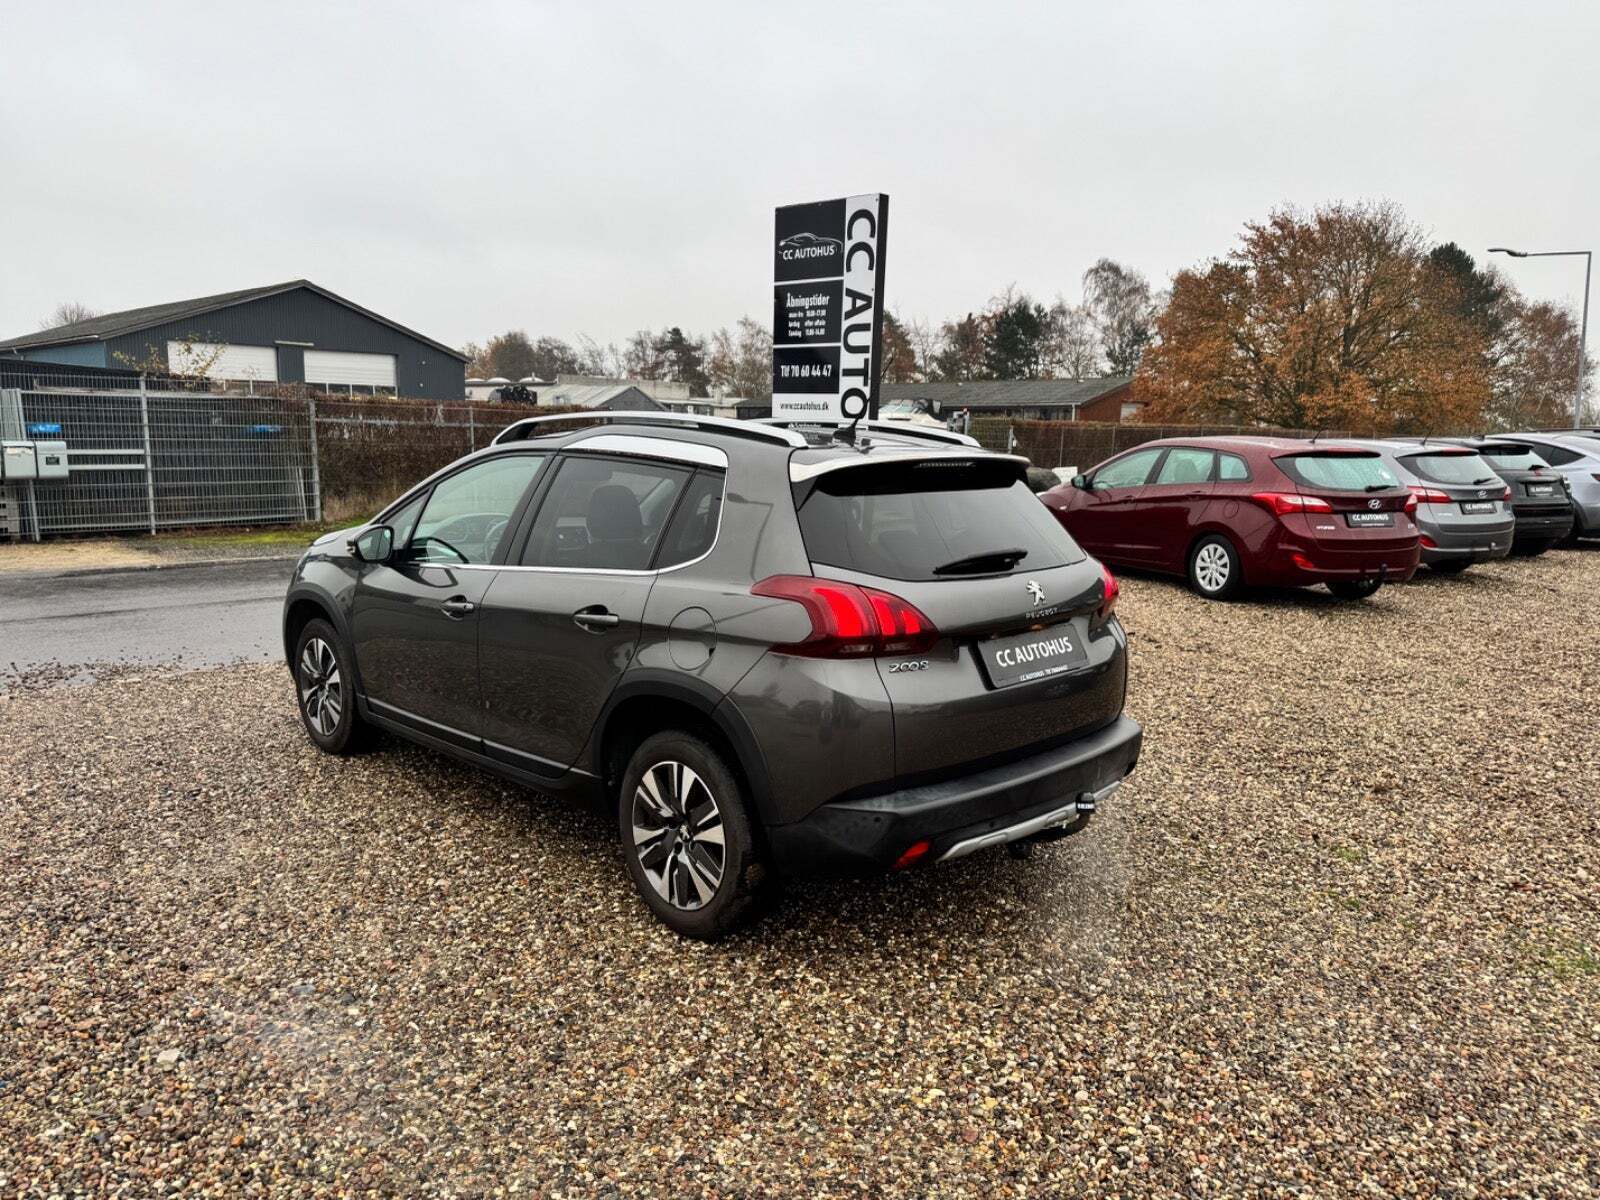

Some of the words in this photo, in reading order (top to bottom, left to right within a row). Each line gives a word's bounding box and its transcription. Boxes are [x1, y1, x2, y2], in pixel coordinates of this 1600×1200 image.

[846, 208, 877, 273] CC
[782, 249, 793, 260] CC
[794, 244, 836, 259] AUTOHUS
[786, 292, 830, 309] Åbningstider
[791, 364, 800, 378] 70
[800, 364, 810, 377] 60
[821, 364, 832, 377] 47
[995, 649, 1015, 668] CC
[1014, 636, 1073, 664] AUTOHUS
[889, 660, 929, 673] 2008
